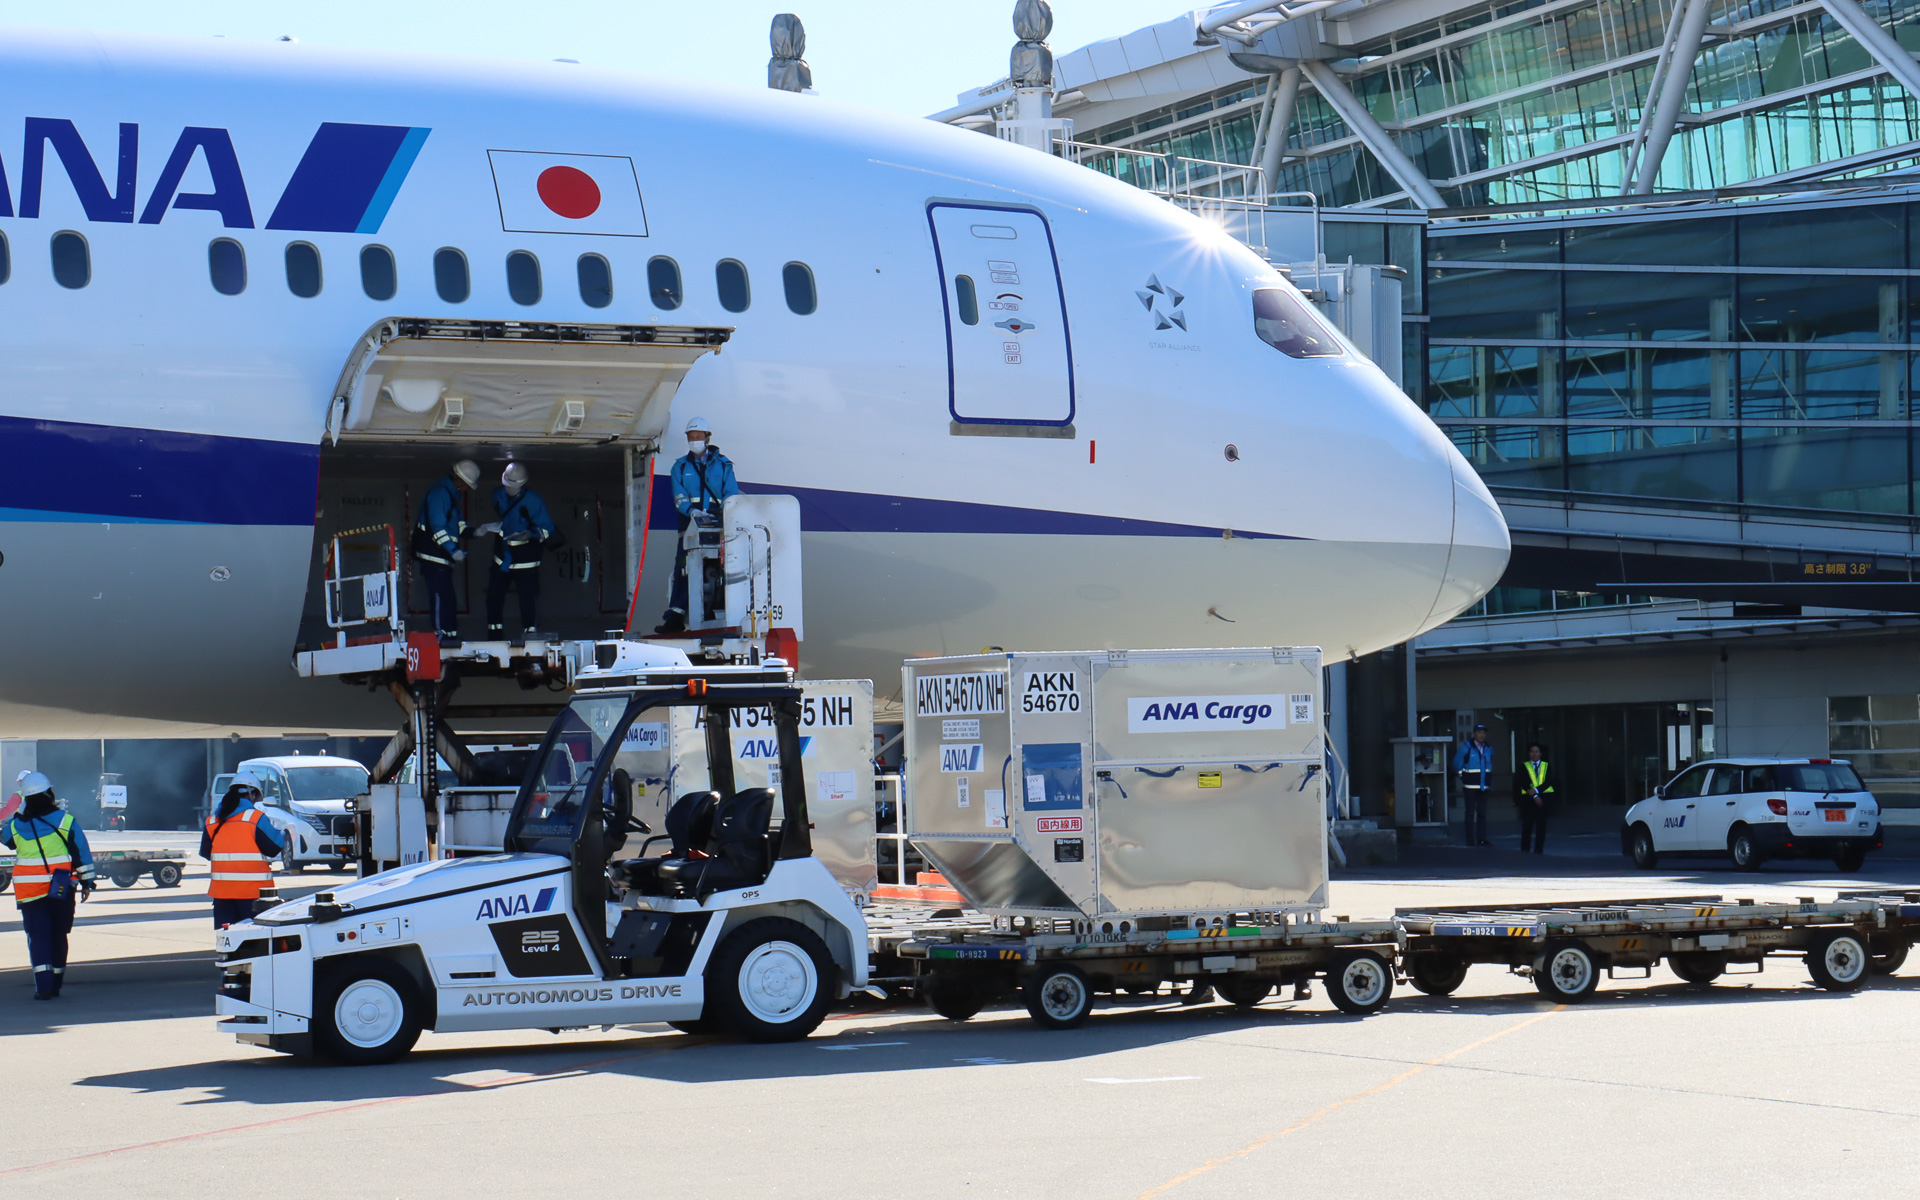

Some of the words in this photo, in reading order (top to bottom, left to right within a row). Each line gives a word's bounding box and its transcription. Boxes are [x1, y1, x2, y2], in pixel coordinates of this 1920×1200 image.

[0, 117, 255, 229] NA
[1168, 344, 1202, 352] ALLIANCE
[1804, 562, 1847, 575] 高さ制限
[407, 647, 420, 672] 59
[1026, 672, 1075, 692] AKN
[918, 677, 943, 714] AKN
[945, 675, 983, 713] 54670
[985, 674, 1004, 711] NH
[1022, 694, 1080, 713] 54670
[822, 696, 853, 726] NH
[1142, 702, 1200, 721] ANA
[1204, 701, 1272, 724] Cargo
[639, 727, 658, 746] Cargo
[942, 748, 968, 771] ANA
[1040, 819, 1080, 830] 国内線用
[1663, 816, 1679, 829] ANA
[741, 890, 760, 899] OPS
[475, 894, 531, 921] ANA
[521, 930, 561, 944] 25
[521, 944, 548, 954] Level
[551, 944, 561, 953] 4
[463, 987, 613, 1007] AUTONOMOUS
[620, 984, 682, 1000] DRIVE
